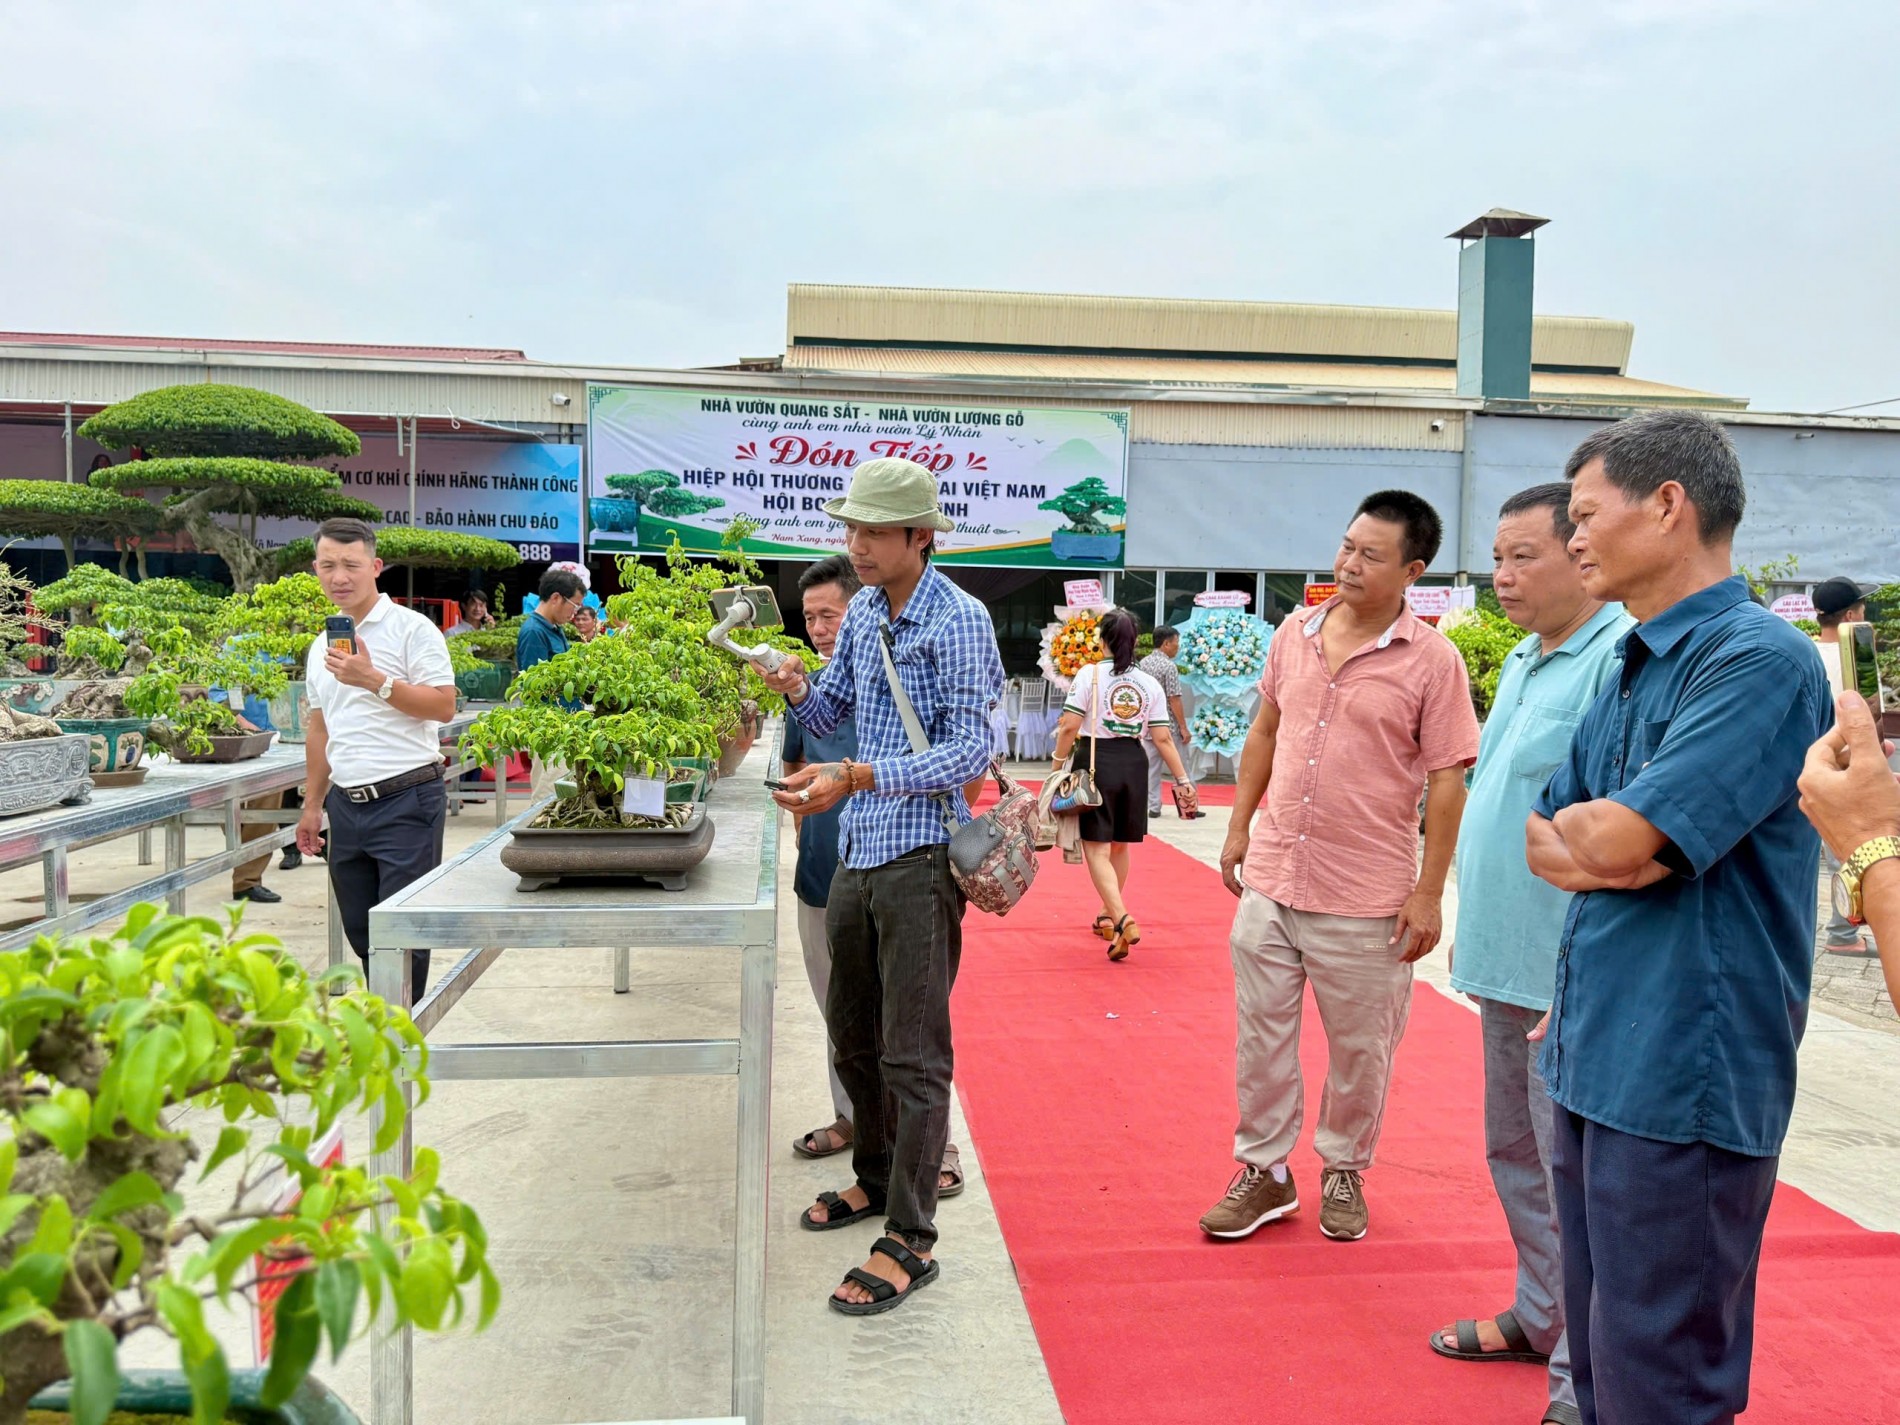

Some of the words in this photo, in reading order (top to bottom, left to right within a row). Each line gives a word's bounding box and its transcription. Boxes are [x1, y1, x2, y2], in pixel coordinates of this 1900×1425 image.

[701, 398, 731, 413] NHÀ
[736, 399, 775, 415] VƯỜN
[780, 402, 828, 418] QUANG
[833, 402, 861, 419] SẮT
[879, 407, 908, 421] NHÀ
[913, 408, 950, 424] VƯỜN
[955, 411, 1001, 428] LƯỢNG
[742, 417, 779, 433] cùng
[784, 419, 813, 431] anh
[817, 424, 840, 432] em
[843, 421, 872, 433] nhà
[876, 424, 912, 435] vườn
[940, 425, 982, 438] Nhân
[769, 435, 858, 467] Đón
[355, 469, 373, 486] CƠ
[377, 468, 401, 486] KHÍ
[449, 471, 488, 490] HÃNG
[492, 471, 539, 492] THÀNH
[542, 474, 578, 493] CÔNG
[683, 467, 726, 489] HIỆP
[733, 469, 764, 490] HỘI
[771, 473, 843, 491] THƯƠNG
[964, 480, 1000, 500] VIỆT
[1006, 484, 1046, 499] NAM
[763, 492, 795, 513] HỘI
[802, 496, 832, 512] BO
[425, 508, 453, 526] BẢO
[458, 508, 496, 527] HÀNH
[500, 513, 527, 529] CHU
[530, 512, 559, 530] ĐÁO
[775, 515, 801, 527] anh
[804, 520, 825, 528] em
[956, 521, 991, 536] thuật
